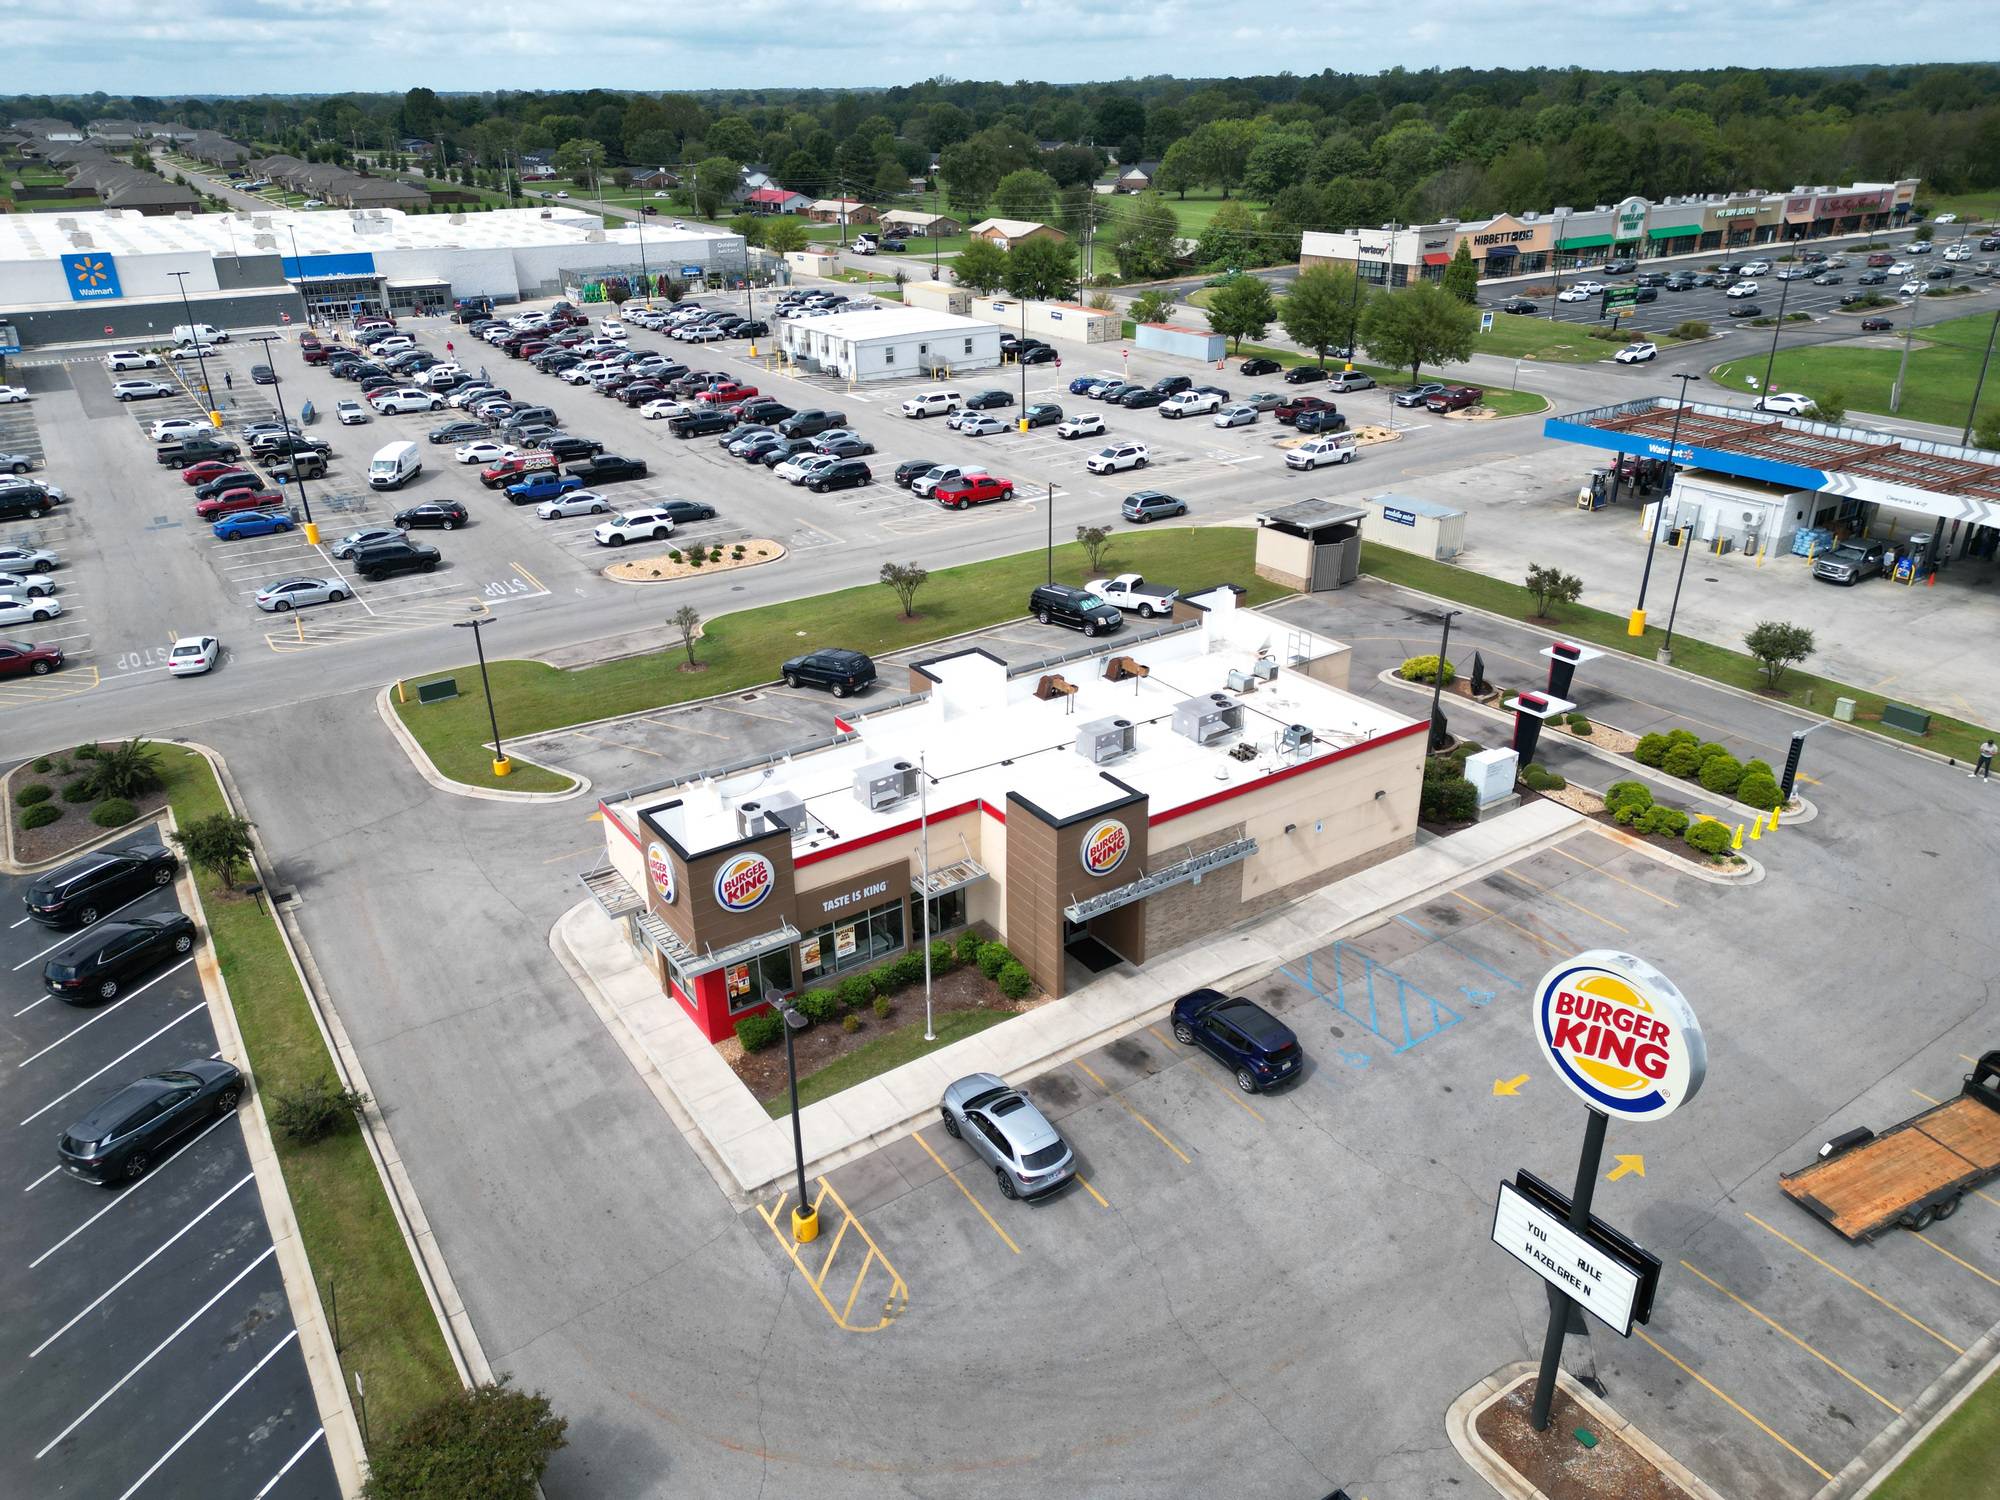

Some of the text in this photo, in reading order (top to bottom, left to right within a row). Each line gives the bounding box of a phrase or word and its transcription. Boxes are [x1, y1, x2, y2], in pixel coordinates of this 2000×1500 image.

[1474, 231, 1511, 246] HIBBETT
[79, 287, 114, 297] Walmart
[484, 578, 529, 597] STOP
[116, 647, 169, 670] STOP
[1090, 828, 1124, 857] BURGER
[1091, 836, 1126, 870] KING
[649, 859, 667, 874] URGER
[724, 861, 766, 893] BURGER
[726, 870, 768, 905] KING
[822, 881, 887, 912] TASTE IS KING
[1554, 991, 1671, 1048] BURGER
[1552, 1017, 1670, 1080] KING
[1527, 1220, 1603, 1282] YOU RULE
